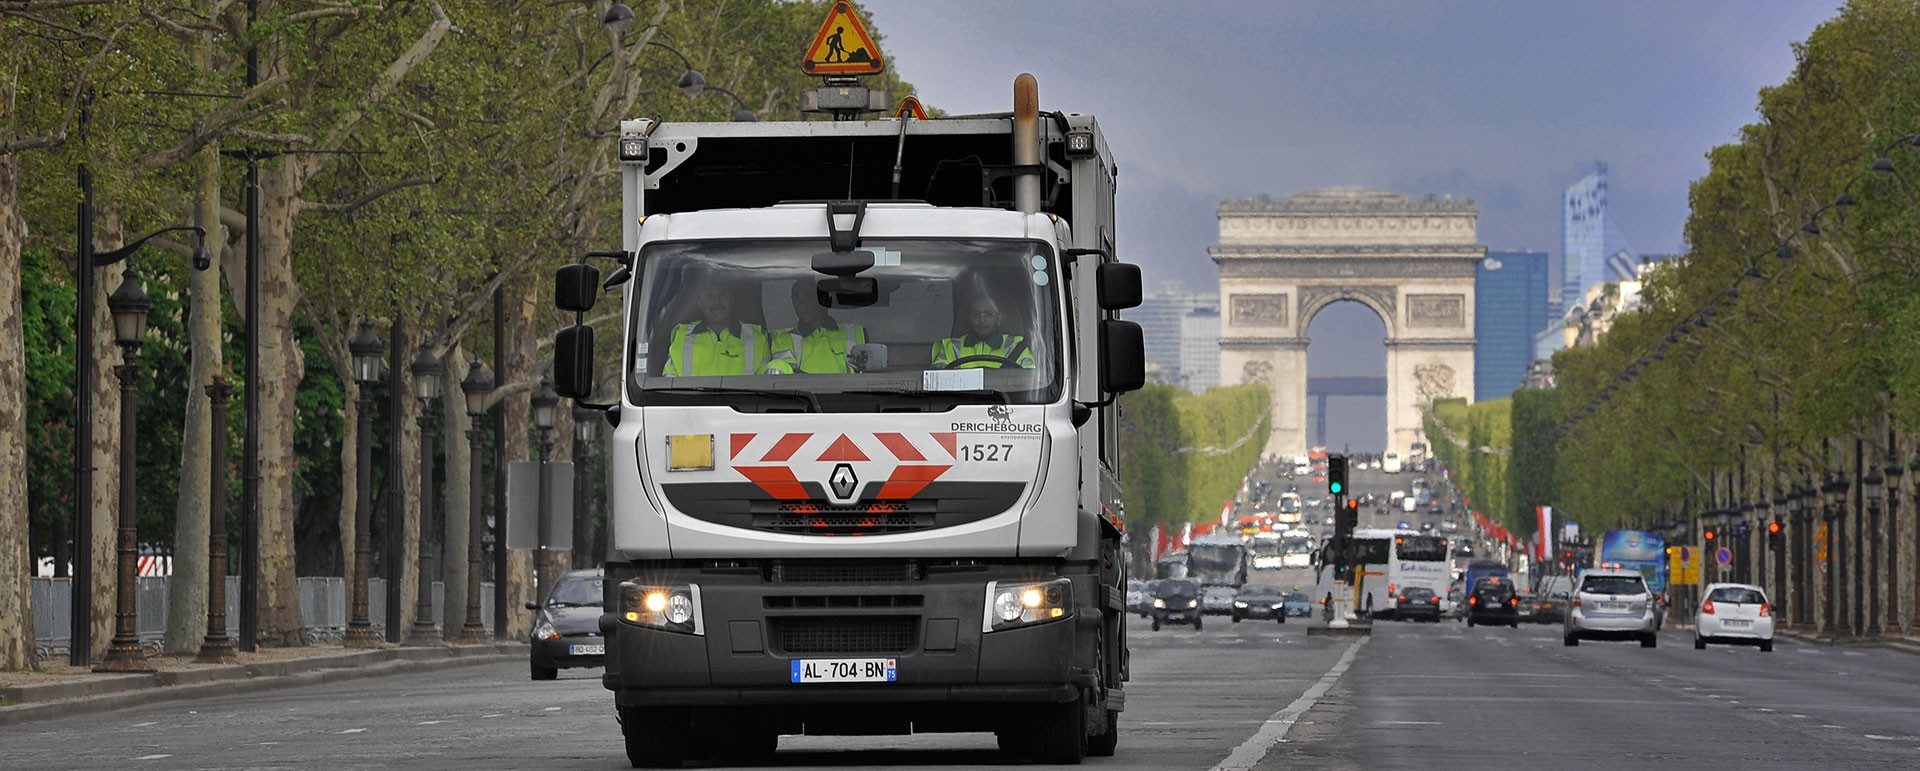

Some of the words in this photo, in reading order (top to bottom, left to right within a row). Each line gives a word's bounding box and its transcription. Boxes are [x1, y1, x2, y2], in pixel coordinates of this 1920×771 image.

[951, 422, 1041, 433] DERICHEBOURG
[961, 444, 1013, 462] 1527
[888, 670, 896, 678] 75
